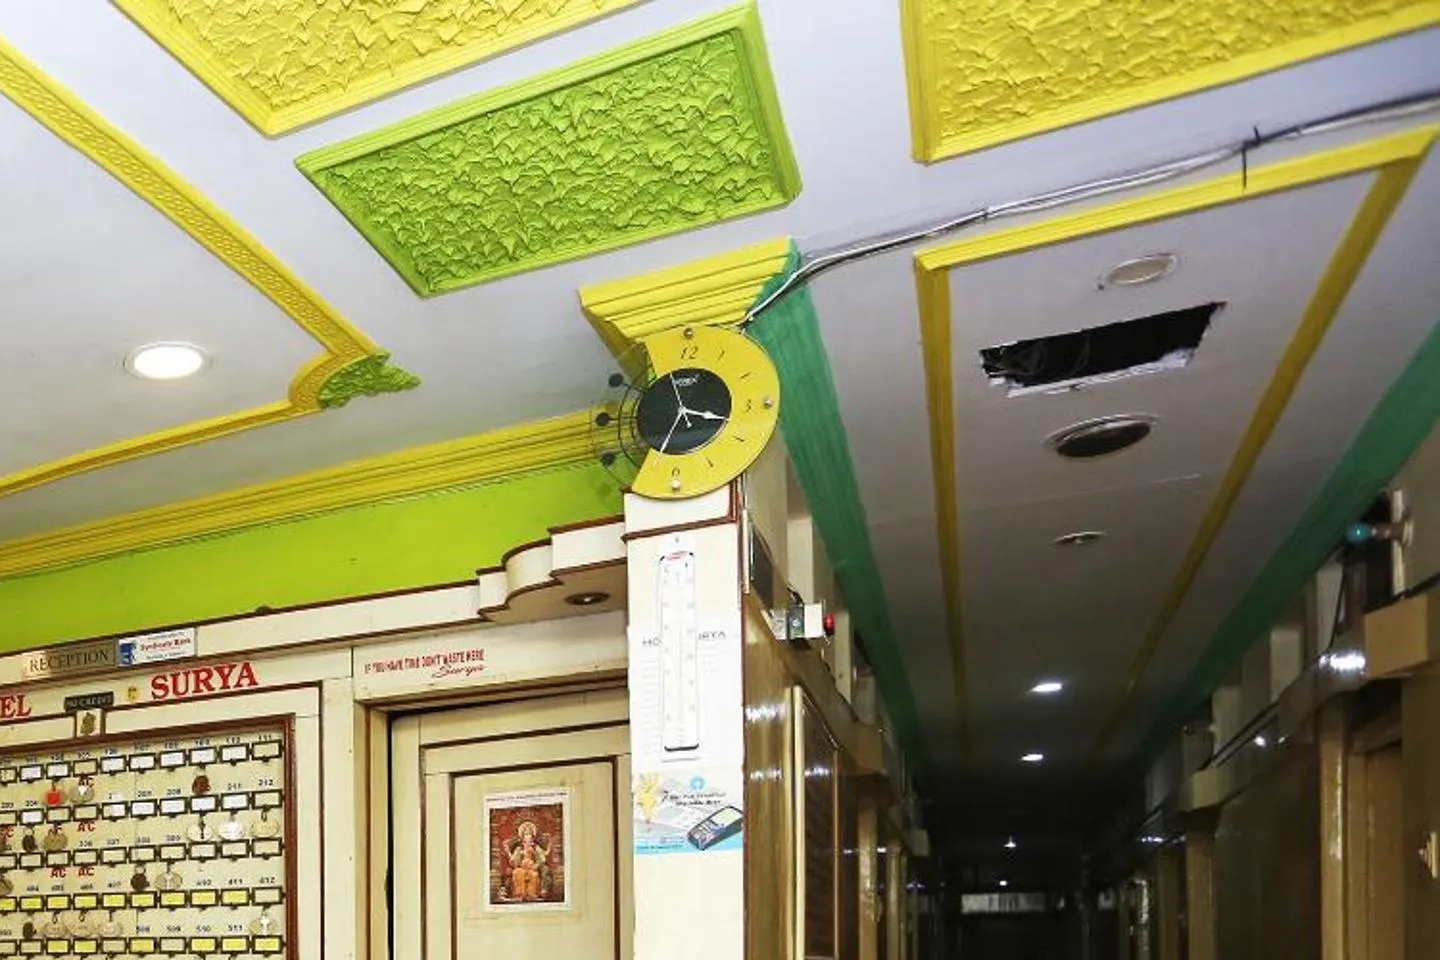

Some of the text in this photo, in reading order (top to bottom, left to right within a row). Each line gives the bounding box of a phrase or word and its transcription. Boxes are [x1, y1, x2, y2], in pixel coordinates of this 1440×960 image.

[680, 346, 699, 360] 12
[29, 649, 109, 673] RECEPTION
[151, 662, 259, 700] SURYA
